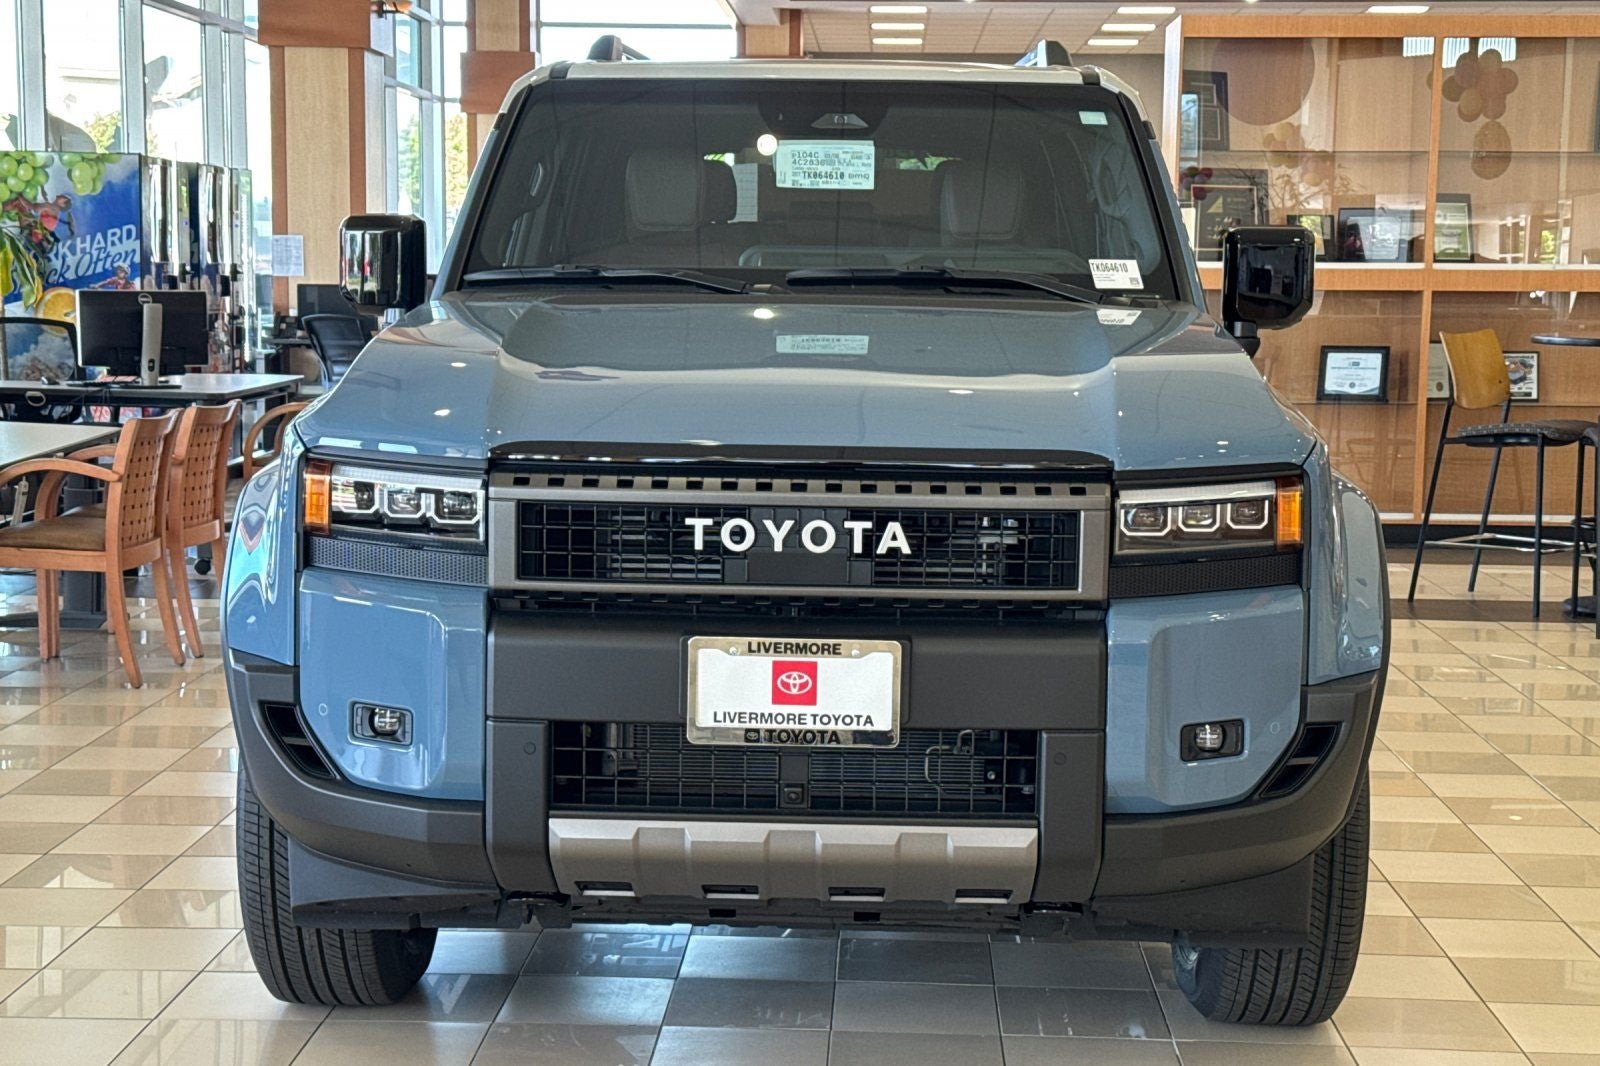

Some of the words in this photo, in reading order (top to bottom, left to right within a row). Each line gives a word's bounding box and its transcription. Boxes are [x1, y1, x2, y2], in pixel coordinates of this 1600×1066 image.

[802, 171, 845, 180] TK064610
[76, 224, 136, 254] HARD
[75, 247, 137, 277] Often
[1090, 262, 1128, 273] TK064610
[684, 517, 912, 555] TOYOTA
[747, 640, 842, 656] LIVERMORE
[713, 710, 808, 726] LIVERMORE
[810, 713, 874, 727] TOYOTA
[765, 728, 841, 745] TOYOTA
